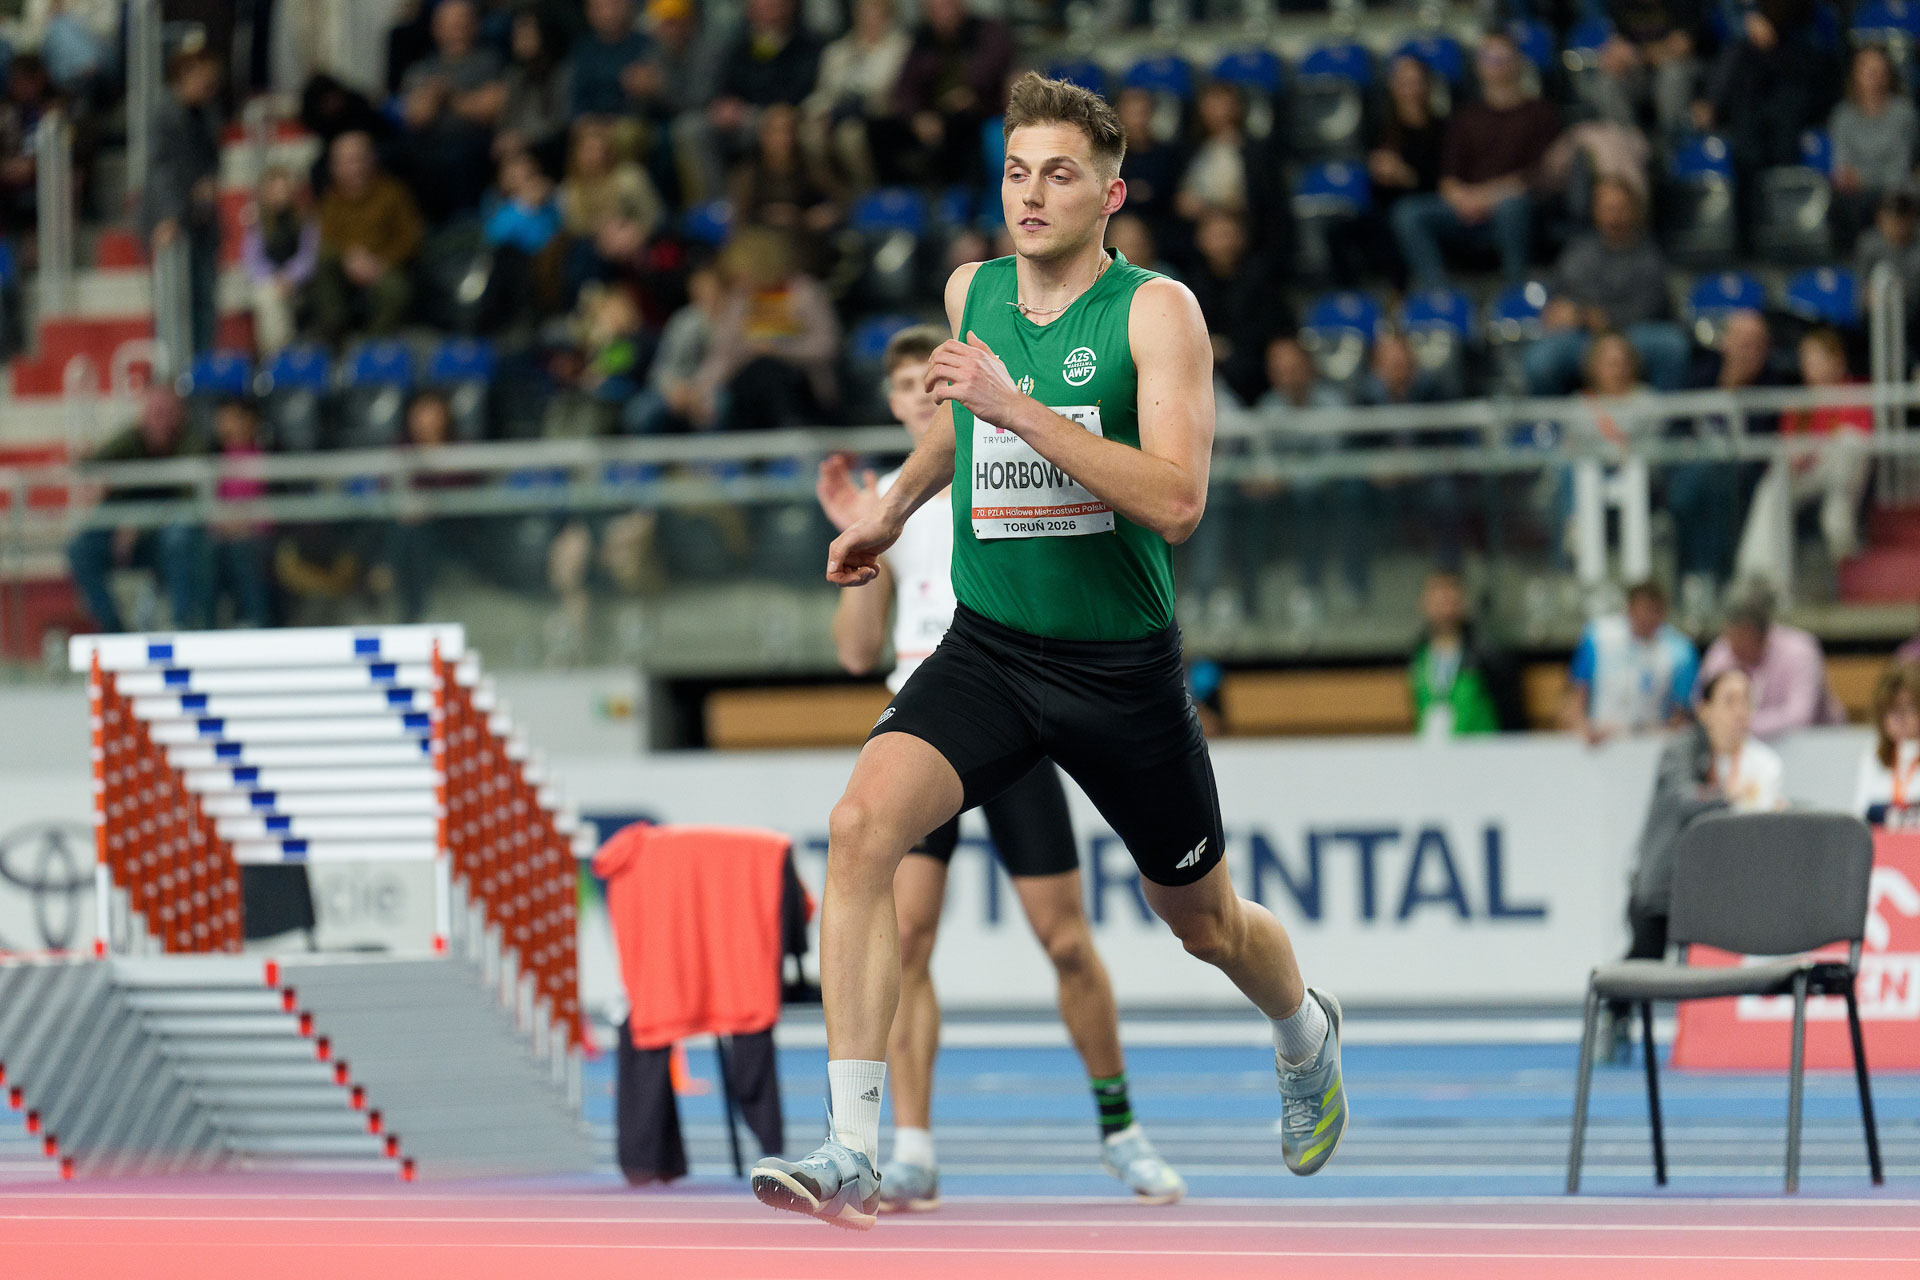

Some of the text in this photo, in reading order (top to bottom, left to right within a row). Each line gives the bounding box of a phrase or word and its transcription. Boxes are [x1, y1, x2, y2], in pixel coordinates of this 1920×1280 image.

[1071, 353, 1090, 363] AZS
[1067, 361, 1093, 369] WARSZAWA
[1067, 367, 1091, 379] AWF
[983, 436, 1018, 444] TRYUMF
[976, 509, 987, 517] 70.
[987, 509, 1005, 517] PZLA
[1081, 503, 1106, 513] Polski
[1003, 519, 1077, 532] TORUŃ 2026
[1089, 826, 1552, 925] RNTAL
